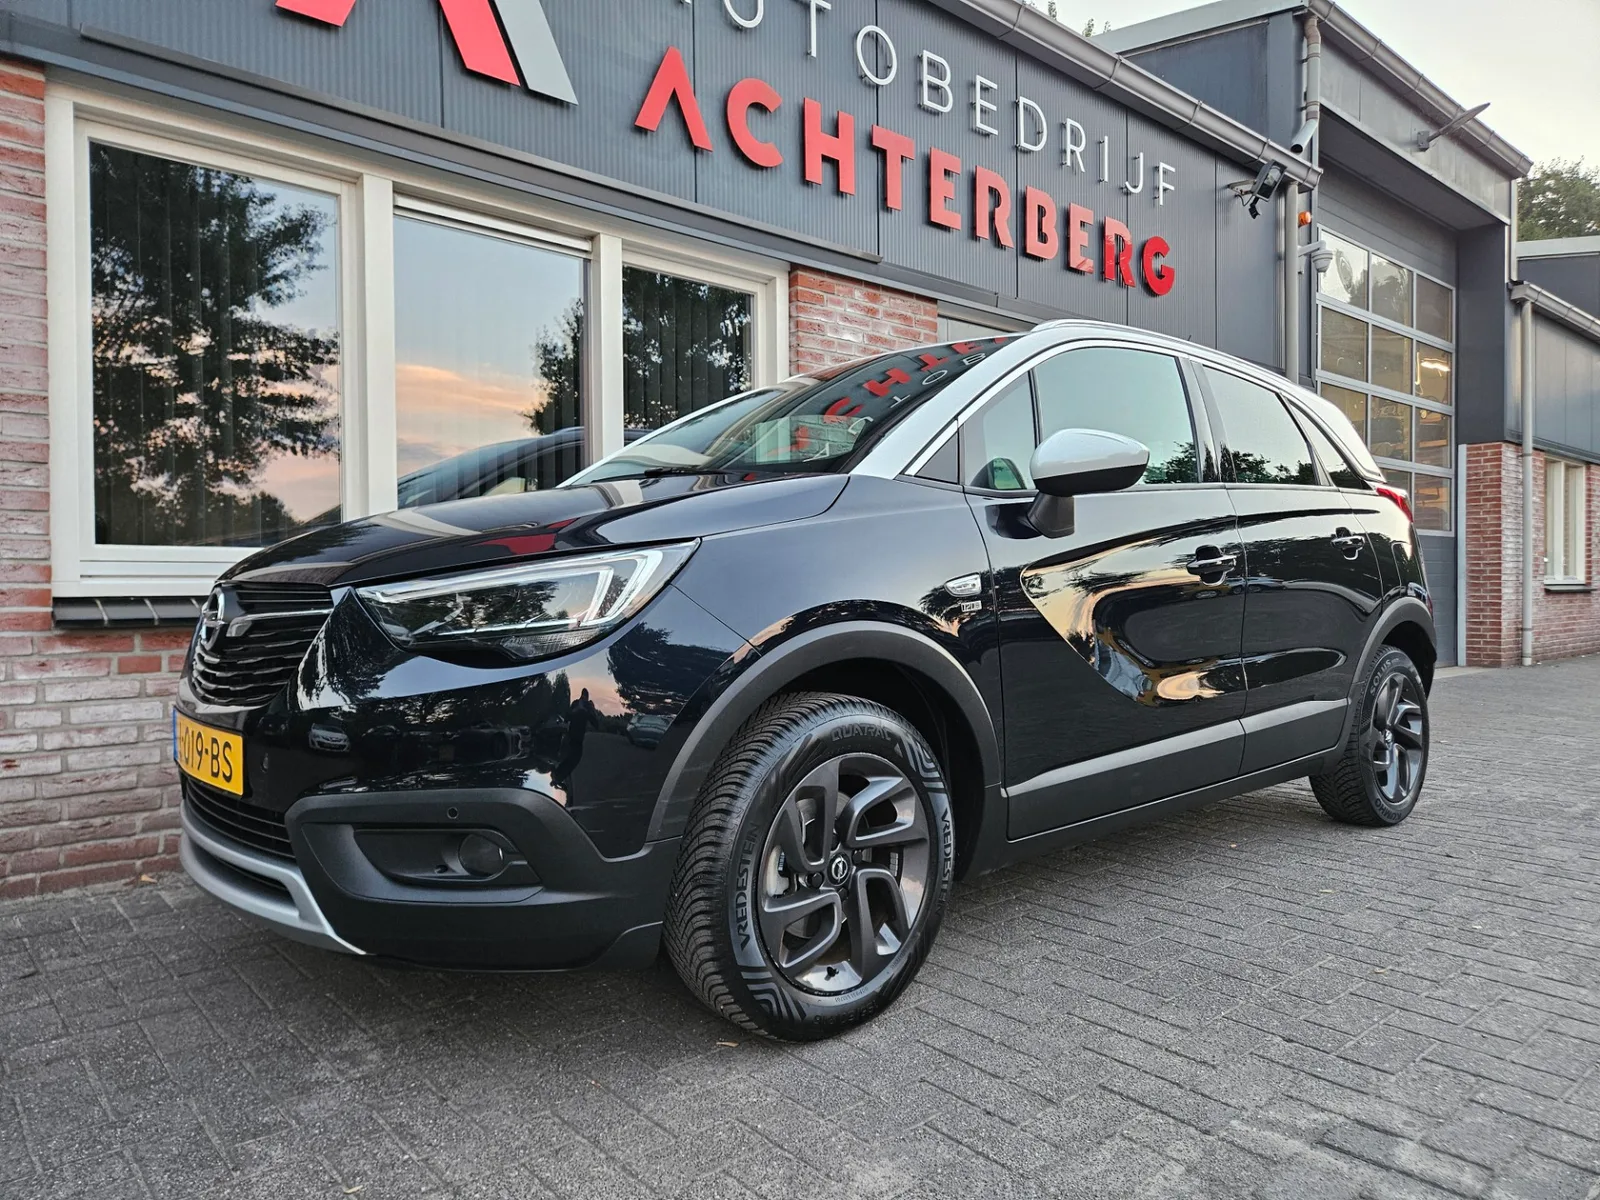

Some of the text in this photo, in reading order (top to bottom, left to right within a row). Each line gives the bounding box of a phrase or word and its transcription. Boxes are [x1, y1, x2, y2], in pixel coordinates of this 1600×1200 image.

[680, 0, 1176, 206] TOBEDRIJF
[634, 46, 1176, 296] ACHTERBERG
[1370, 659, 1391, 696] SOLUS
[830, 723, 892, 741] QUATRAC
[1375, 798, 1402, 820] KUMHO
[735, 823, 760, 951] VREDESTEIN
